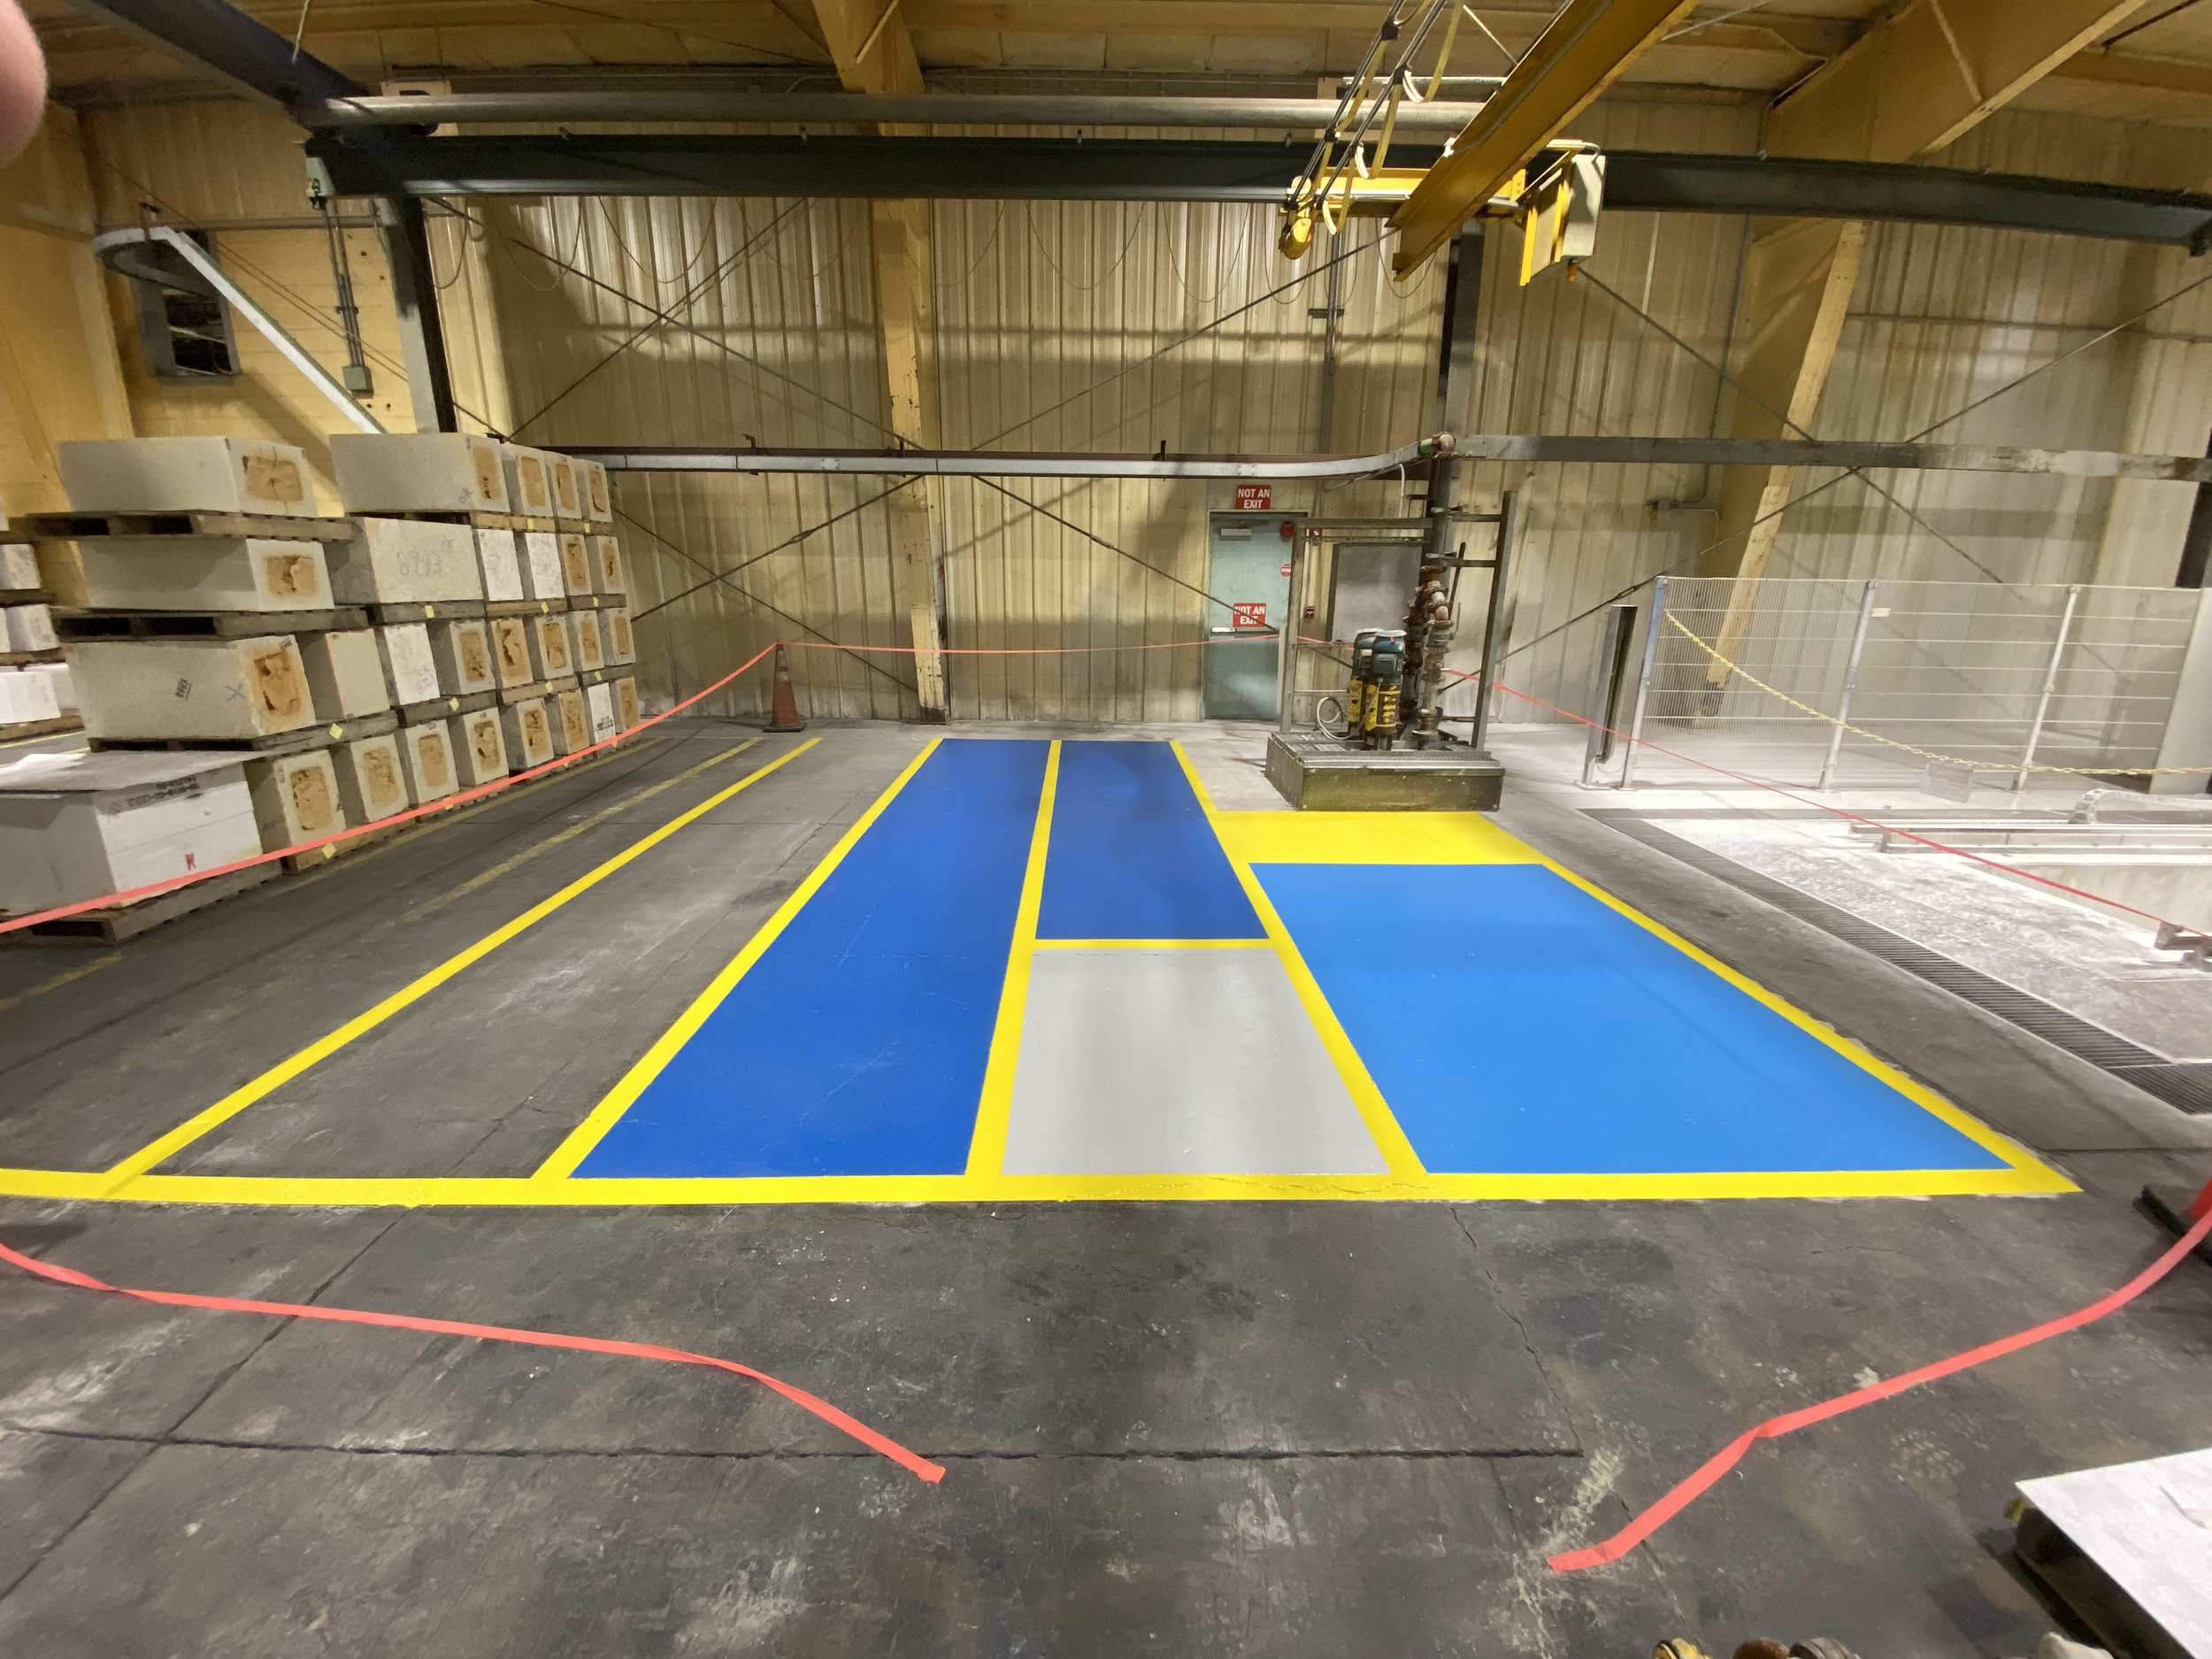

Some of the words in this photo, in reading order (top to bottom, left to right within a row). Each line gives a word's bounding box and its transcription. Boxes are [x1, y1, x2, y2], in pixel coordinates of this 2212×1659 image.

[1238, 488, 1256, 498] NOT
[1257, 488, 1271, 498] AN
[1243, 499, 1263, 509] EXIT
[1233, 605, 1252, 615] NOT
[1252, 605, 1265, 615] AN
